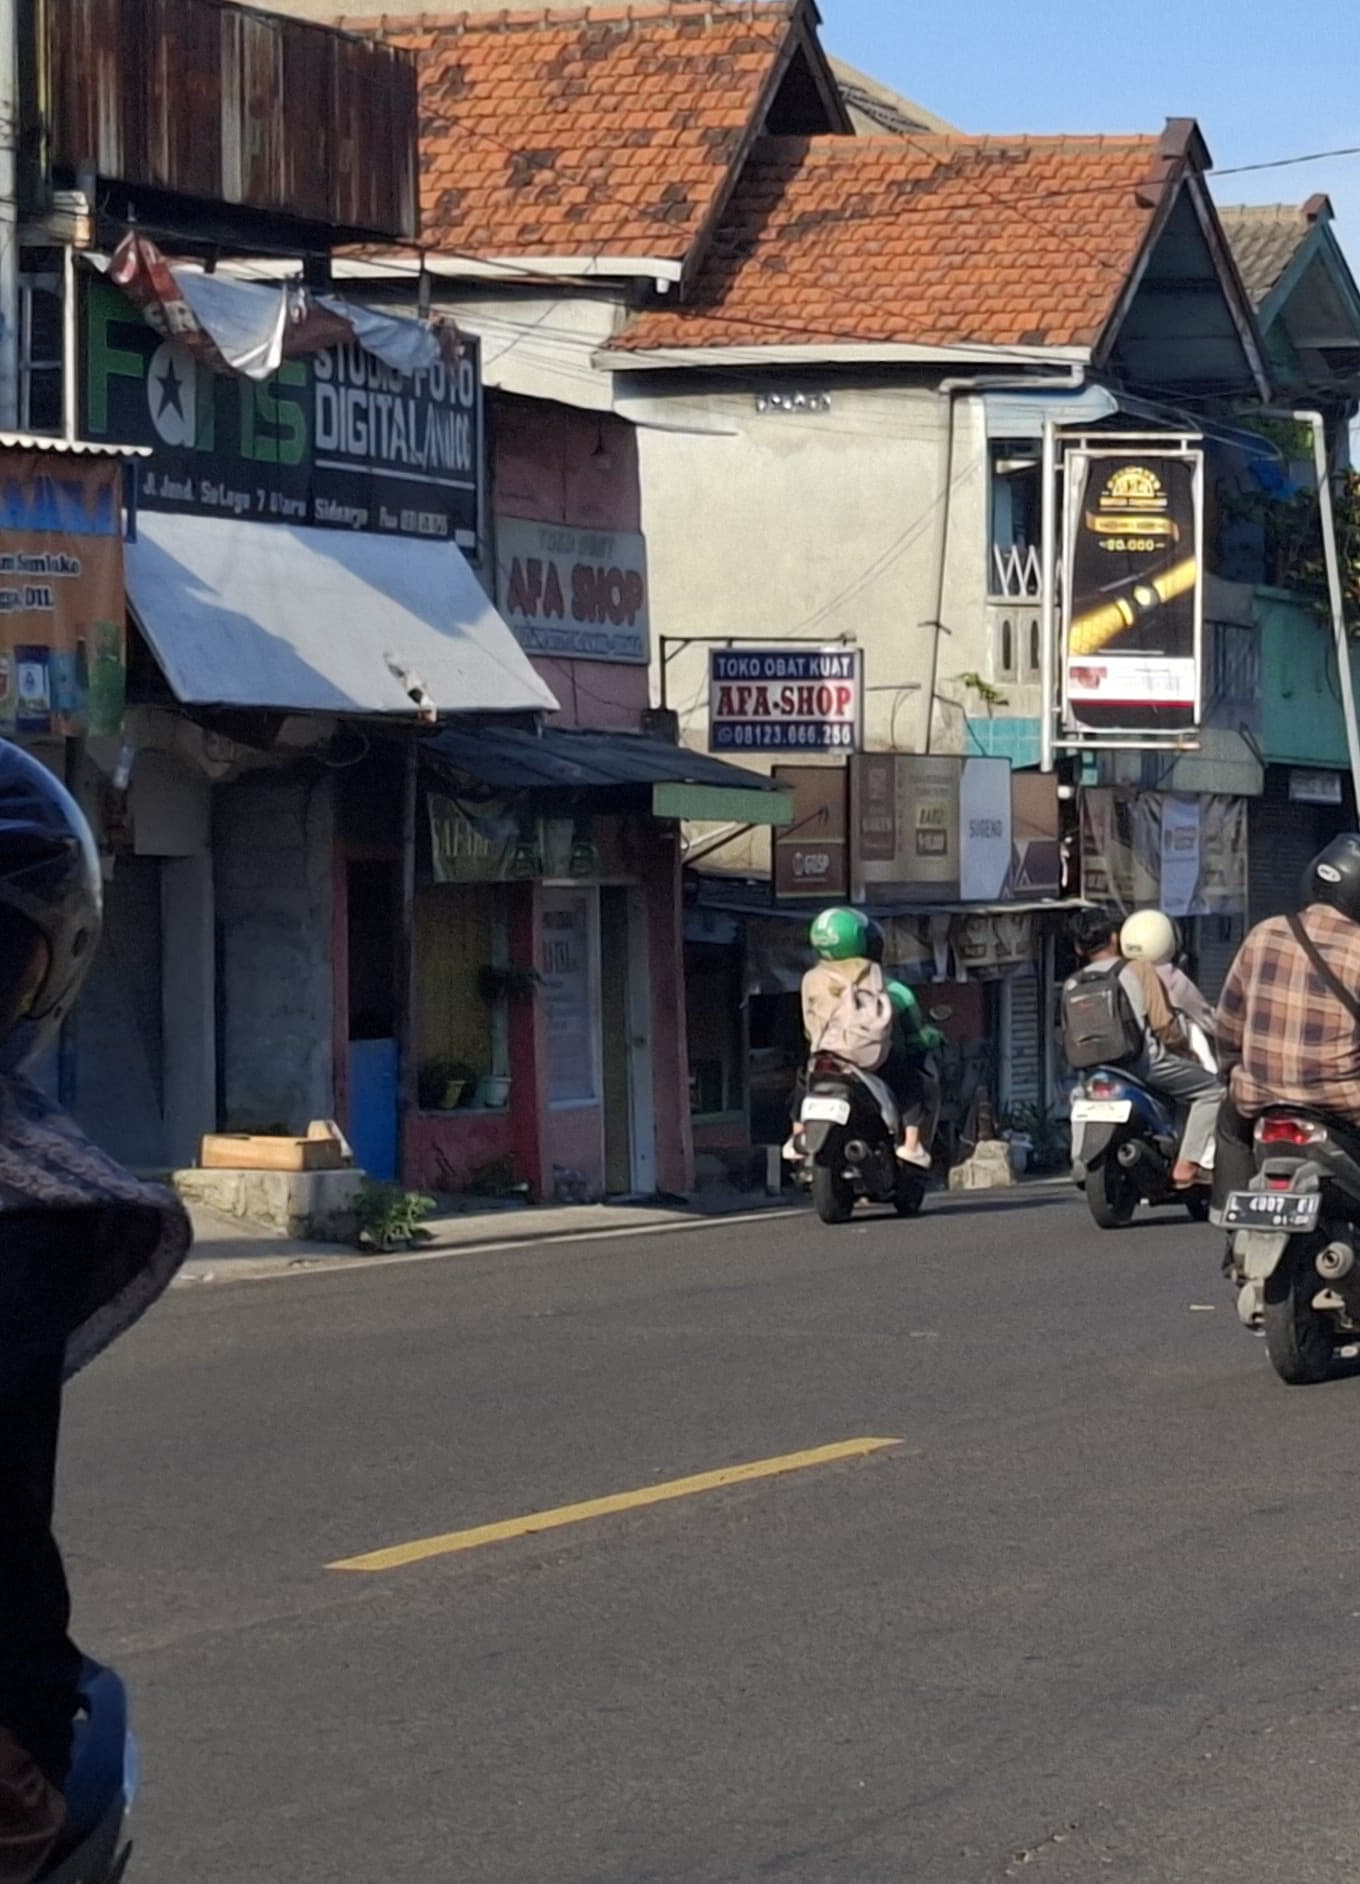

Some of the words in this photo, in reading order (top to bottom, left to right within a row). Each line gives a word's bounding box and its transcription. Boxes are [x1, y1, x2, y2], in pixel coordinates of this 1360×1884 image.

[507, 556, 564, 620] AFA
[571, 563, 644, 627] SHOP
[718, 658, 760, 676] TOKO
[764, 658, 806, 676] OBAT
[809, 656, 851, 676] KUAT
[717, 685, 853, 716] AFA-SHOP
